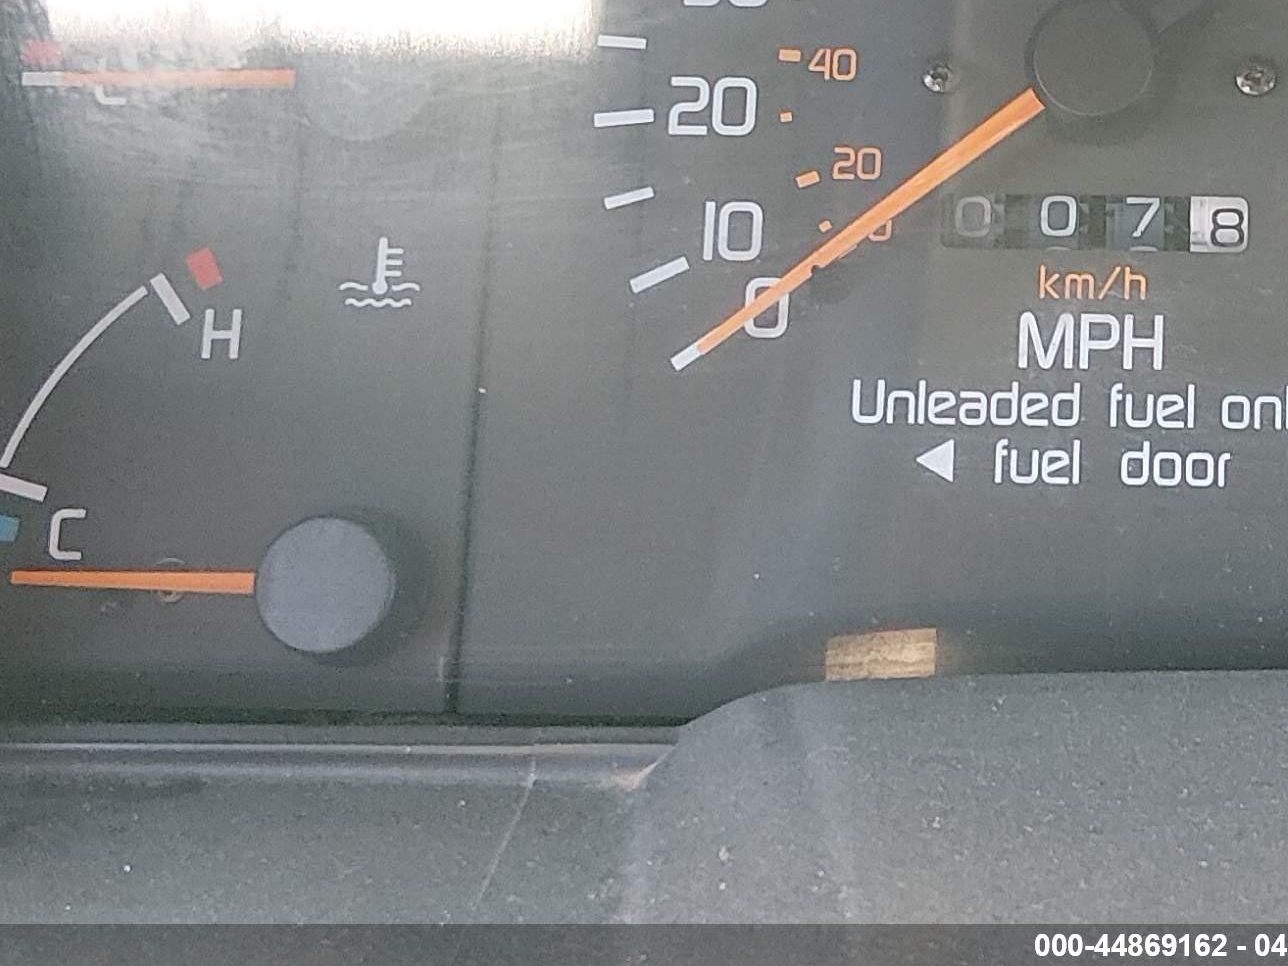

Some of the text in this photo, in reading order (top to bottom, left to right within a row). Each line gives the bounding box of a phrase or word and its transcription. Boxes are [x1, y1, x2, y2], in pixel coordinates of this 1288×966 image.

[808, 48, 857, 81] 40
[668, 76, 757, 136] 20
[832, 146, 882, 180] 20
[702, 201, 763, 261] 10
[742, 276, 790, 339] 0
[1039, 265, 1146, 300] km/h
[201, 308, 243, 360] H
[1018, 311, 1164, 371] MPH
[852, 379, 1081, 427] Unleaded
[1109, 382, 1195, 429] fuel
[994, 438, 1231, 488] fuel door
[48, 508, 87, 561] C
